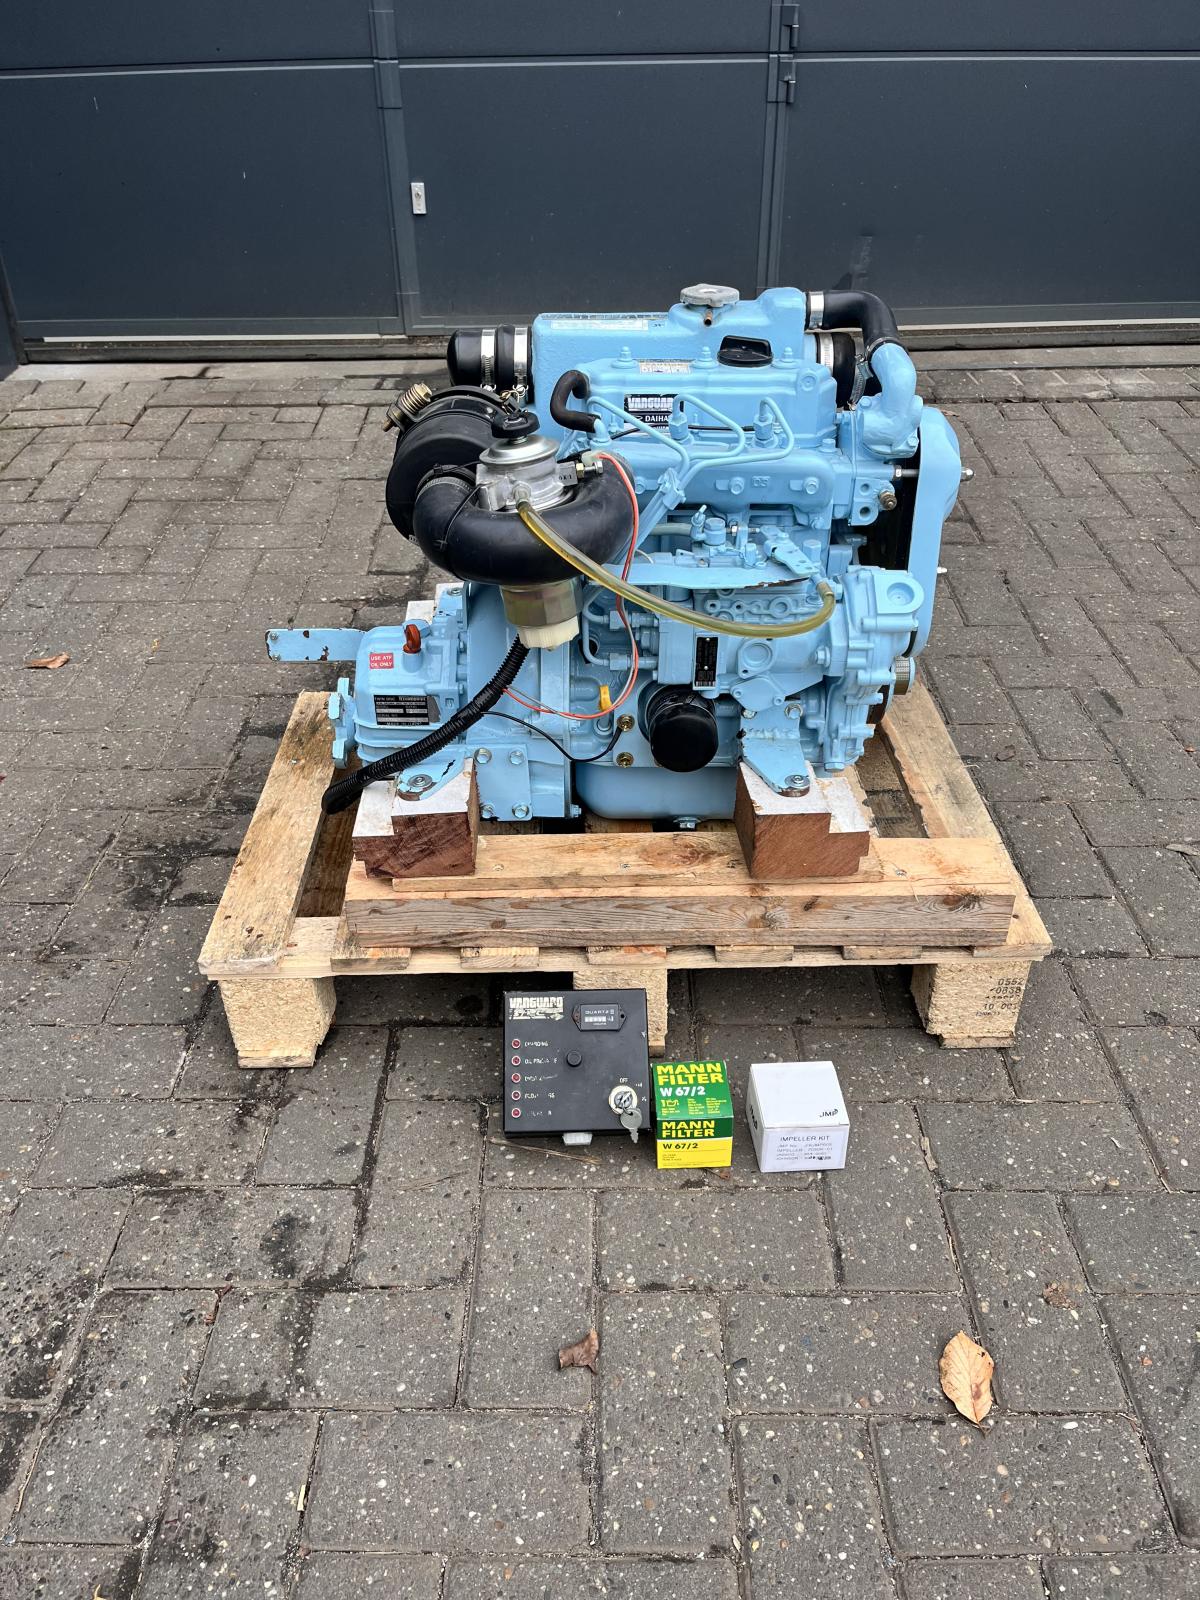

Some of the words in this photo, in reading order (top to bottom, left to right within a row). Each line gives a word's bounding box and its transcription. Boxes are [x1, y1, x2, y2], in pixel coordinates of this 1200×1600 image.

[627, 397, 673, 409] VANGUAR
[509, 996, 564, 1009] VANGUARD
[656, 1062, 722, 1075] MANN
[657, 1072, 724, 1086] FILTER
[660, 1087, 673, 1097] W
[675, 1085, 706, 1097] 67/2
[662, 1120, 715, 1130] MANN
[662, 1128, 715, 1138] FILTER
[674, 1142, 699, 1150] 67/2
